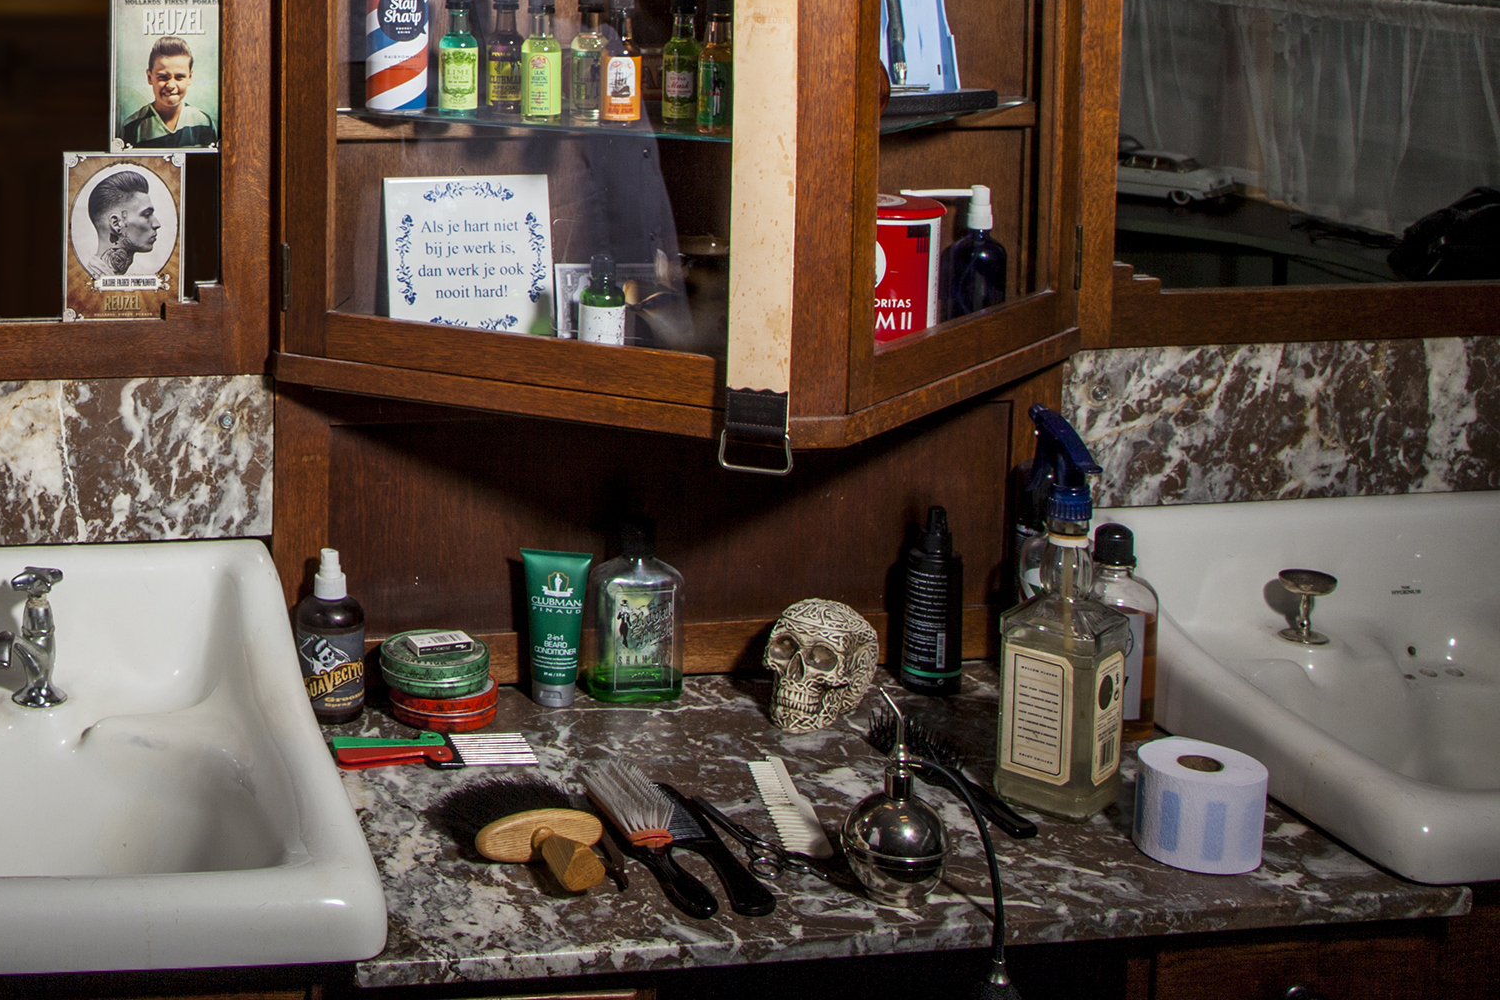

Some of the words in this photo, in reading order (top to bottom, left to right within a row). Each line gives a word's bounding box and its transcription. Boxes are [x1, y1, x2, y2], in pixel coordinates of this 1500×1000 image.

[143, 8, 207, 36] REUZEL
[383, 8, 423, 27] Sharp
[420, 219, 446, 233] Als
[447, 219, 461, 236] je
[463, 218, 491, 233] hart
[493, 217, 519, 232] niet
[425, 241, 443, 259] bij
[445, 241, 460, 258] je
[462, 241, 498, 255] werk
[500, 240, 516, 256] is,
[417, 263, 440, 277] dan
[446, 263, 481, 277] werk
[483, 262, 496, 279] je
[498, 261, 526, 275] ook
[435, 285, 472, 299] nooit
[474, 283, 509, 298] hard!
[104, 295, 142, 312] REUZEL
[531, 595, 584, 607] CLUBMAN
[532, 606, 582, 615] PINAUD
[533, 645, 578, 656] CONDITIONER
[543, 640, 568, 649] BEARD
